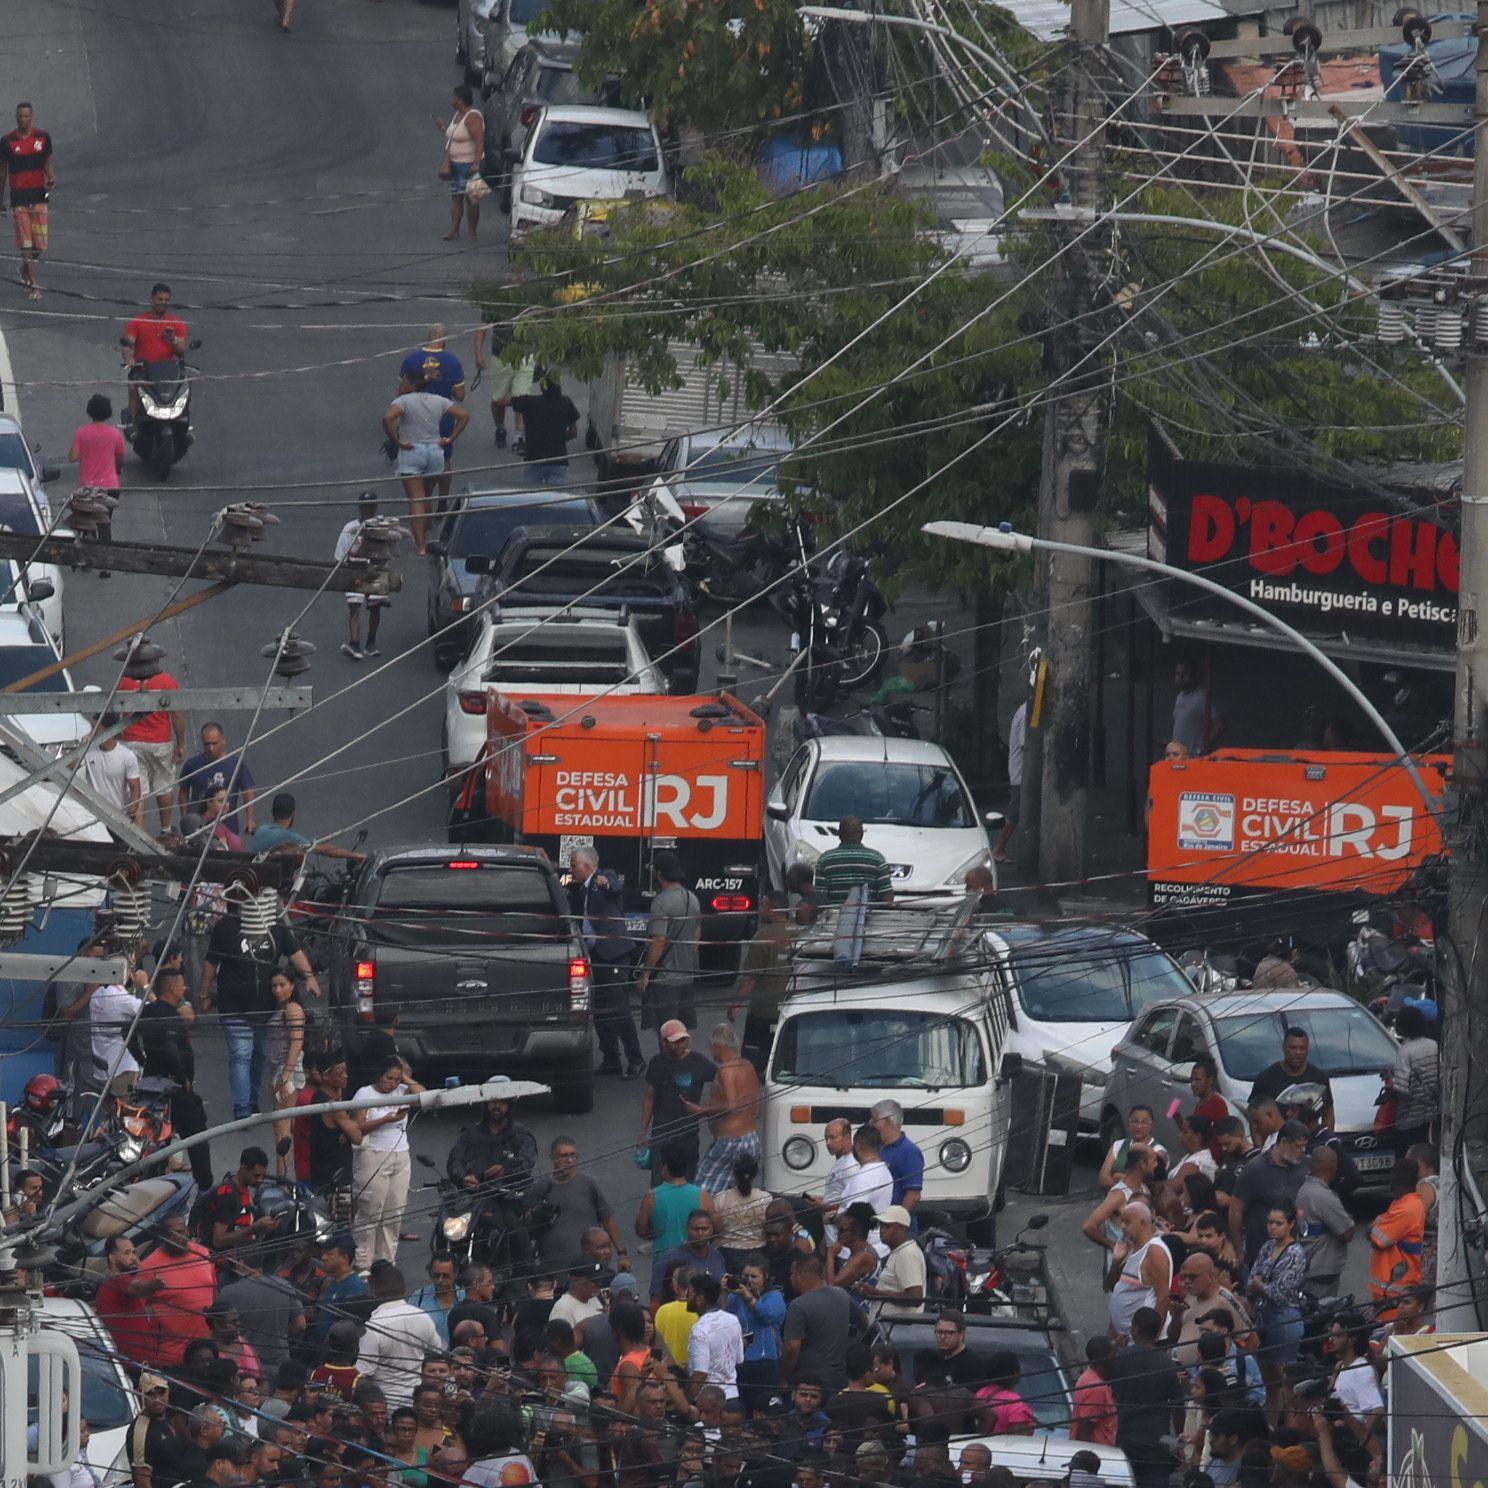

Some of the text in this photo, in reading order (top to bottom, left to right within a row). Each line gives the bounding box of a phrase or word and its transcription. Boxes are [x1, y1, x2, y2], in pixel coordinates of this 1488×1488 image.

[1251, 579, 1392, 615] Hamburgueria e
[555, 771, 728, 829] DEFESA RJ
[555, 788, 635, 812] CIVIL
[554, 813, 634, 828] ESTADUAL
[1241, 814, 1320, 840] CIVIL
[1242, 798, 1413, 860] DEFESA RJ
[1241, 840, 1320, 856] ESTADUAL
[695, 878, 743, 890] ARC-157
[1154, 883, 1231, 896] RECOLHIMENTO
[1154, 894, 1167, 904] DE
